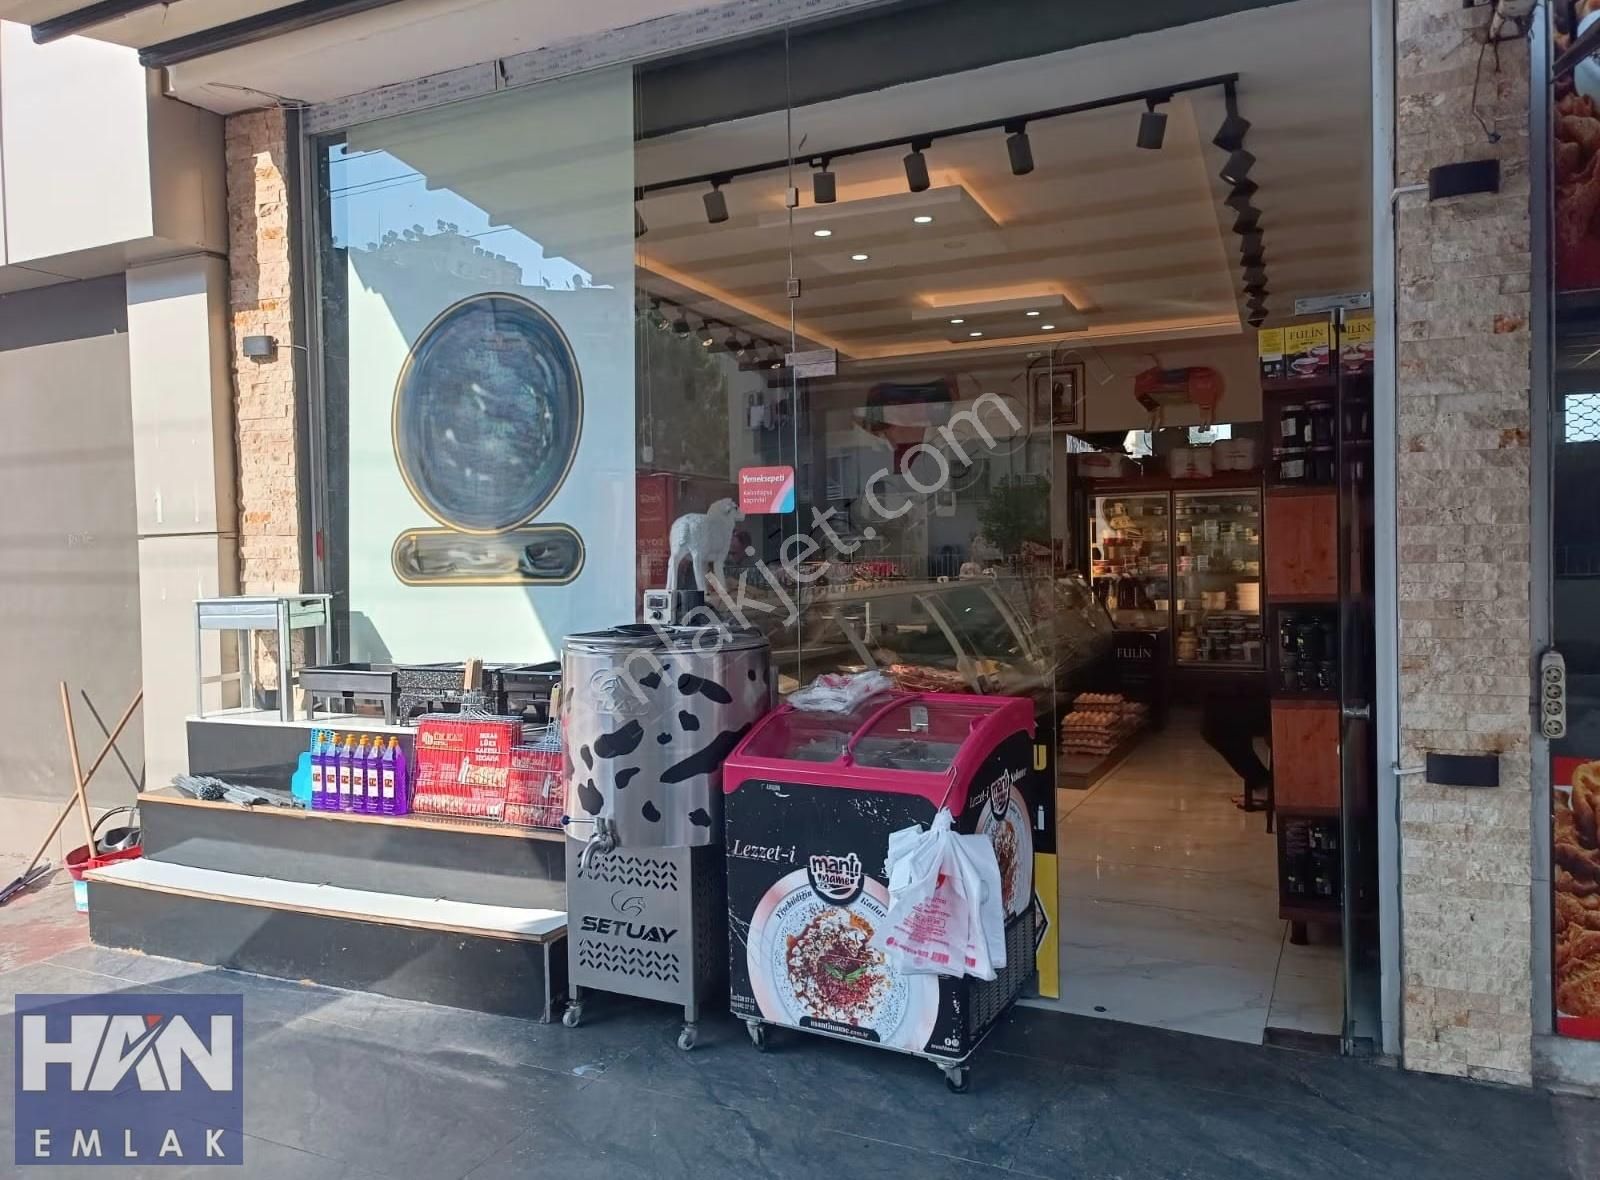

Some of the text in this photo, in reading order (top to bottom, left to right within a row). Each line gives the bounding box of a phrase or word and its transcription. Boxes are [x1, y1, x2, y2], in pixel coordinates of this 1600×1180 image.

[733, 839, 796, 863] Lezzet-i
[860, 897, 887, 918] Kadar
[580, 915, 678, 943] SETUAY
